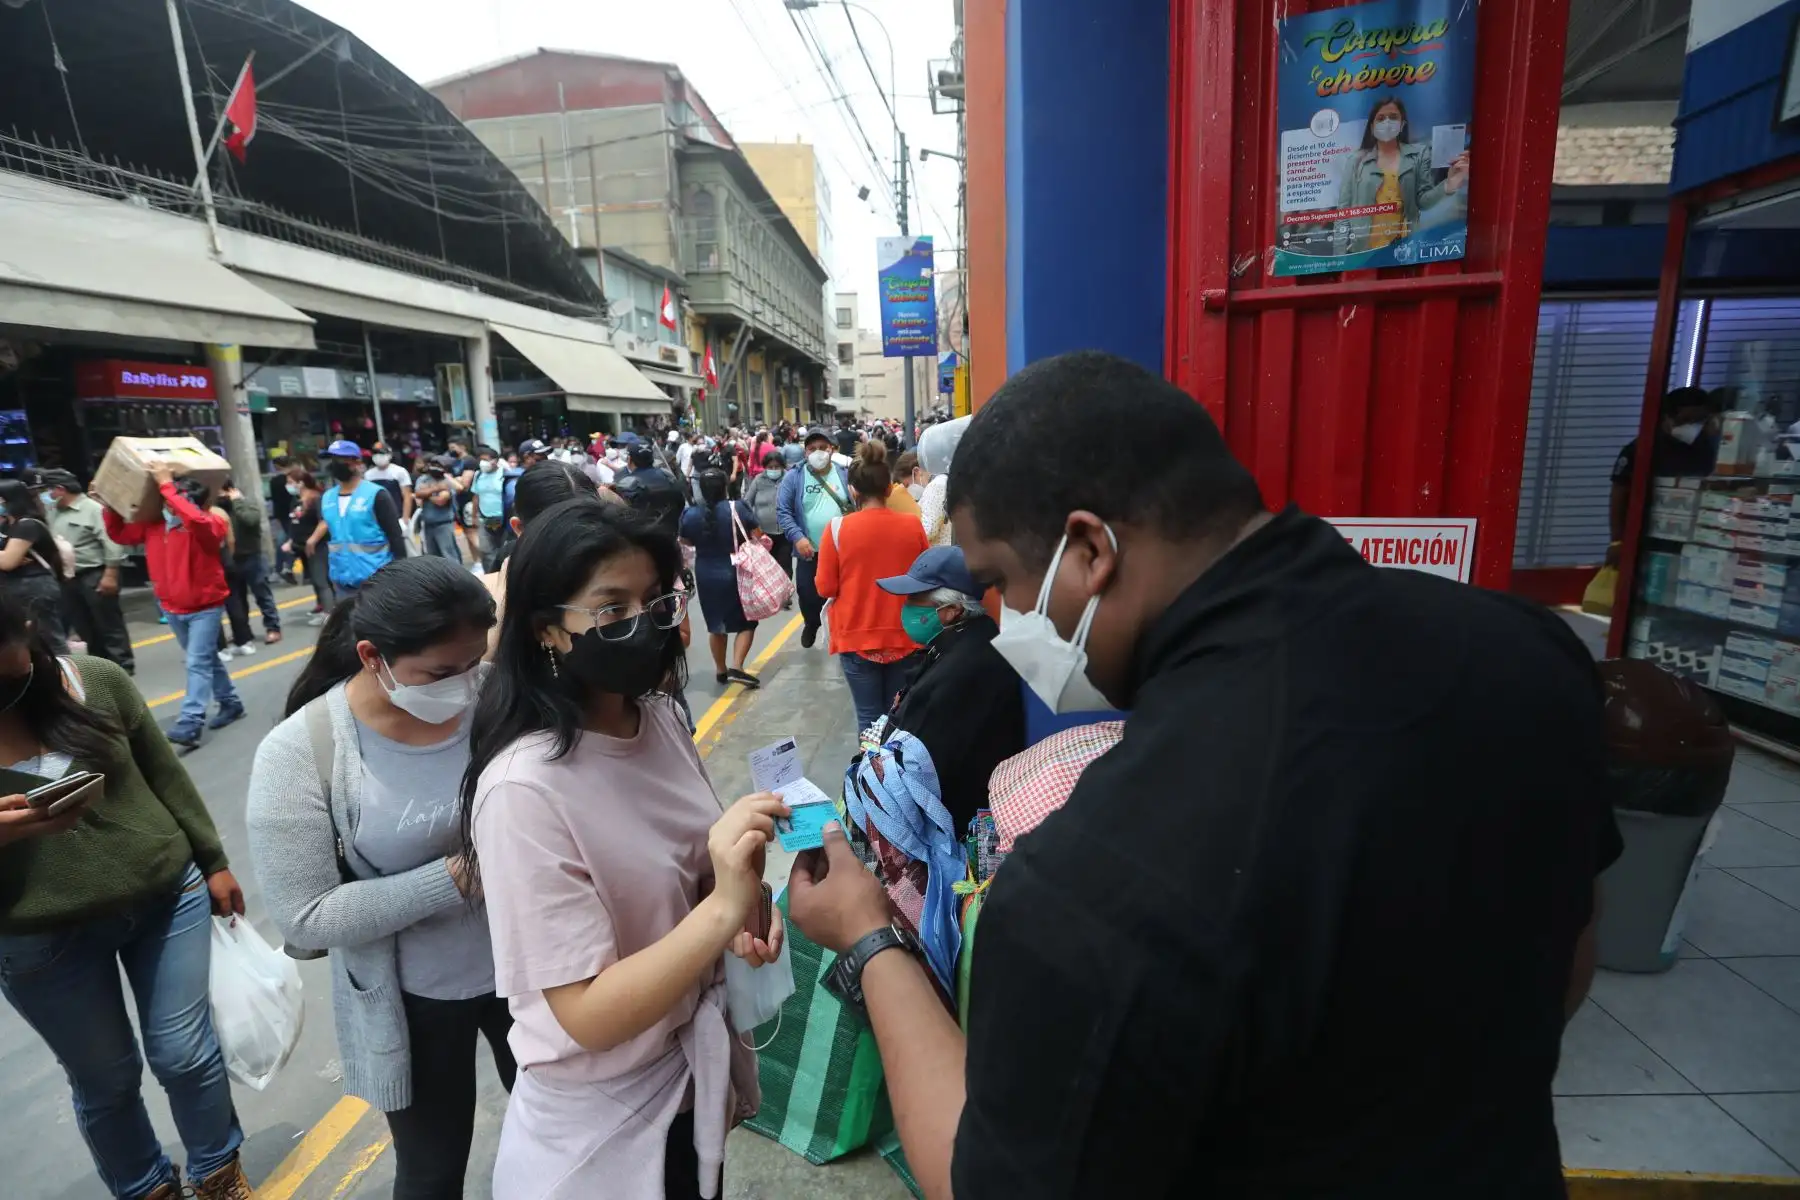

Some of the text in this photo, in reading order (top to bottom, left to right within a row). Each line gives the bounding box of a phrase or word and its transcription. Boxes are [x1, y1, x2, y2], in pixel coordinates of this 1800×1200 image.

[1304, 18, 1448, 62] Compra
[1317, 61, 1437, 97] chévere
[1287, 145, 1308, 153] Desde
[1287, 151, 1321, 160] diciembre
[1287, 159, 1320, 169] presentar
[1287, 167, 1306, 175] carné
[1286, 172, 1326, 182] vacunación
[1286, 180, 1332, 191] para ingresar
[1292, 189, 1322, 198] espacios
[1286, 214, 1311, 223] Decreto
[1311, 212, 1338, 222] Supremo
[1350, 204, 1394, 216] 168-2021-PCM
[1420, 244, 1461, 259] LIMA
[180, 375, 207, 388] PRO
[1360, 532, 1458, 566] ATENCIÓN
